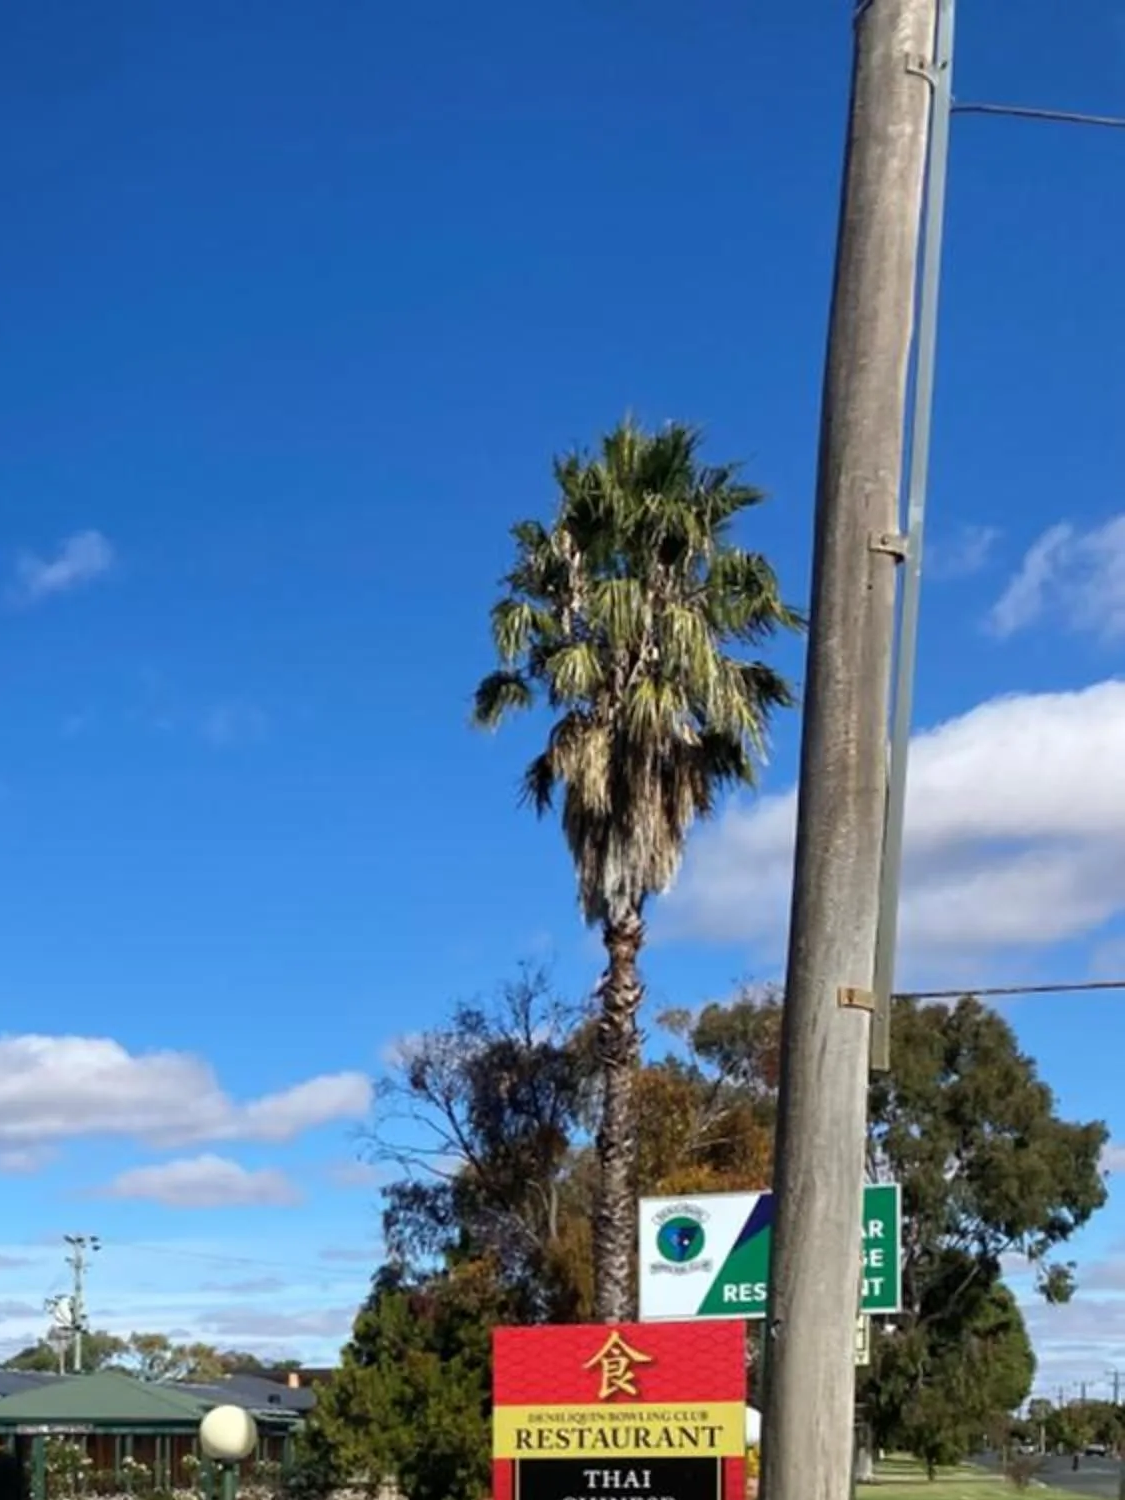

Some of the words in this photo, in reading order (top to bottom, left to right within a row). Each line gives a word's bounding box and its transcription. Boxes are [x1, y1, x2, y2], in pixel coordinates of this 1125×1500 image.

[583, 1330, 653, 1400] 食
[608, 1411, 672, 1423] BOWLING
[674, 1410, 709, 1422] CLUB
[515, 1425, 724, 1450] RESTAURANT
[583, 1469, 652, 1489] THAI
